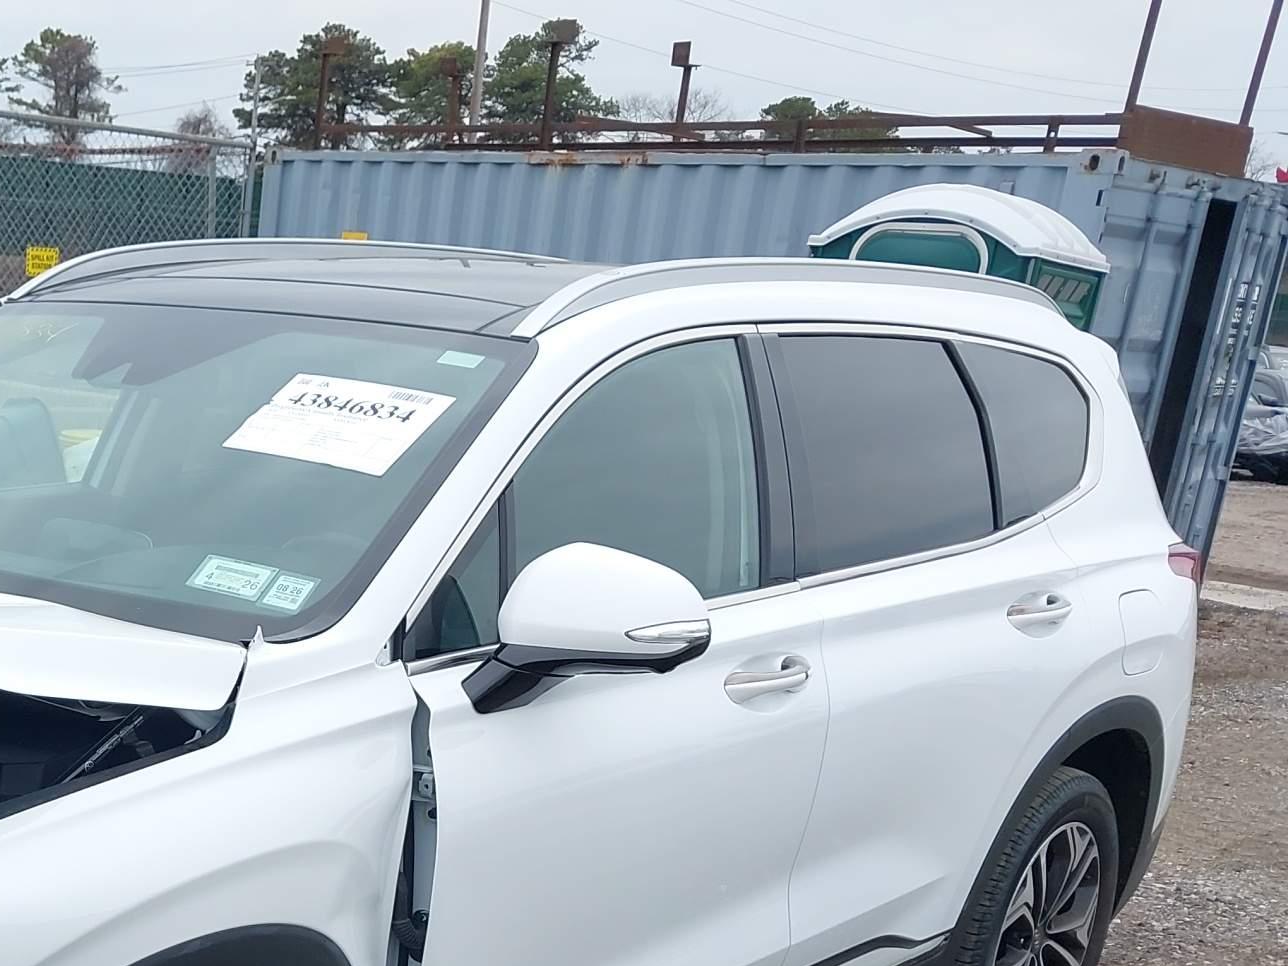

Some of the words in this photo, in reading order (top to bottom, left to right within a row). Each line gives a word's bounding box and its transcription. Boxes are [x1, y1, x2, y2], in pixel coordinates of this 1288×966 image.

[288, 391, 417, 423] 43846834
[241, 579, 261, 591] 26
[277, 583, 288, 593] 08
[290, 586, 305, 596] 26
